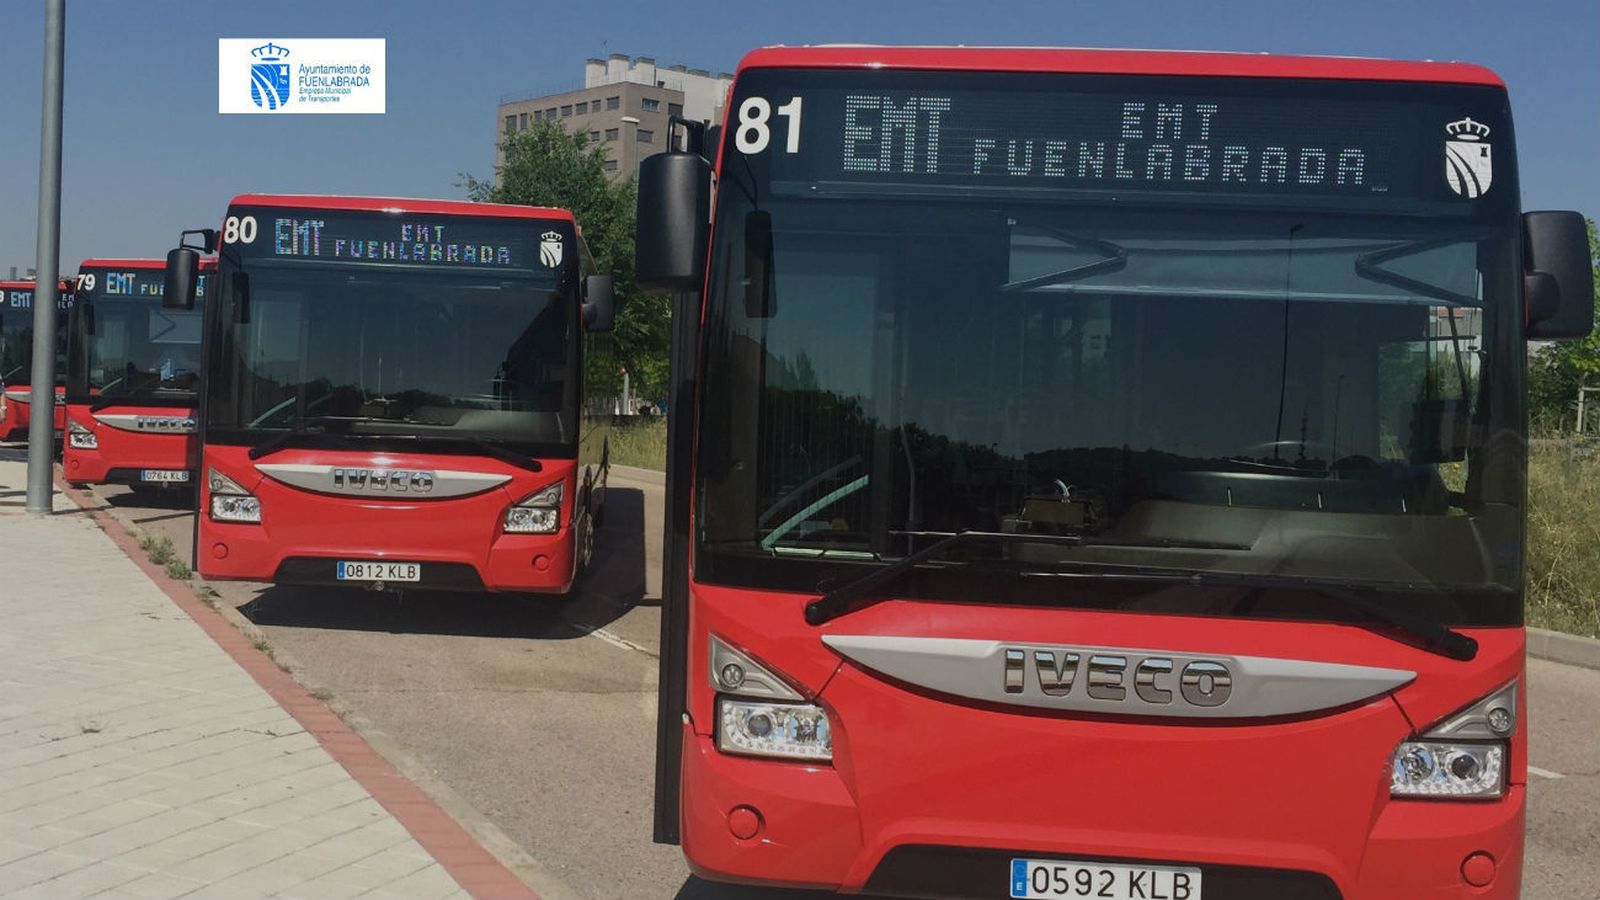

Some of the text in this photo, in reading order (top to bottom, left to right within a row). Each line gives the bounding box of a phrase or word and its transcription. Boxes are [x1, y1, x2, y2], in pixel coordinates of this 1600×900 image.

[735, 97, 803, 155] 81
[843, 95, 951, 174] EMT
[1121, 102, 1218, 140] EMT
[972, 137, 1367, 185] FUENLABRADA
[224, 216, 257, 244] 80
[275, 218, 325, 256] EMT
[401, 223, 445, 243] EMT
[334, 239, 511, 265] FUENLABRADA
[77, 273, 96, 291] 79
[106, 272, 136, 295] EMT
[10, 291, 31, 308] EMT
[146, 471, 167, 480] 0764
[334, 468, 433, 493] IVECO
[346, 564, 416, 579] 0812 KLB
[1004, 649, 1232, 707] IVECO
[1031, 865, 1115, 897] 0592
[1128, 869, 1192, 900] KLB
